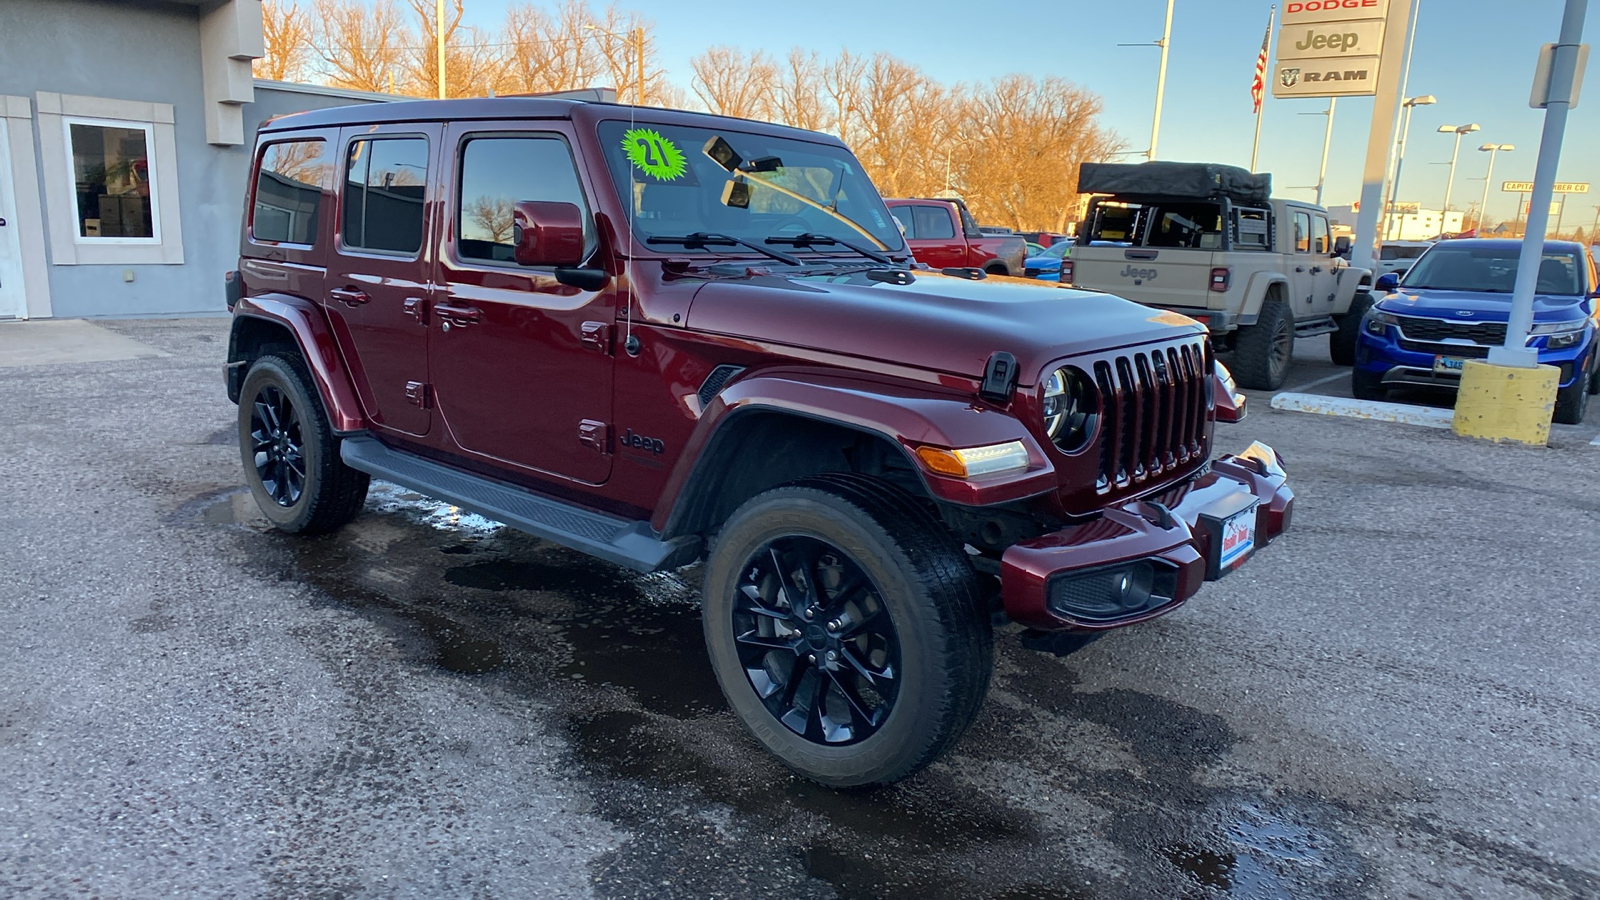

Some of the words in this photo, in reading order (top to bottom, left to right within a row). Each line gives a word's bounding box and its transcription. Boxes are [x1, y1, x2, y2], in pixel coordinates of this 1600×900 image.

[1287, 0, 1377, 13] DODGE
[1296, 30, 1359, 52] Jeep
[1303, 70, 1368, 82] RAM
[636, 138, 670, 167] 21
[1574, 184, 1585, 192] CO
[1120, 264, 1158, 281] Jeep
[620, 427, 664, 456] Jeep
